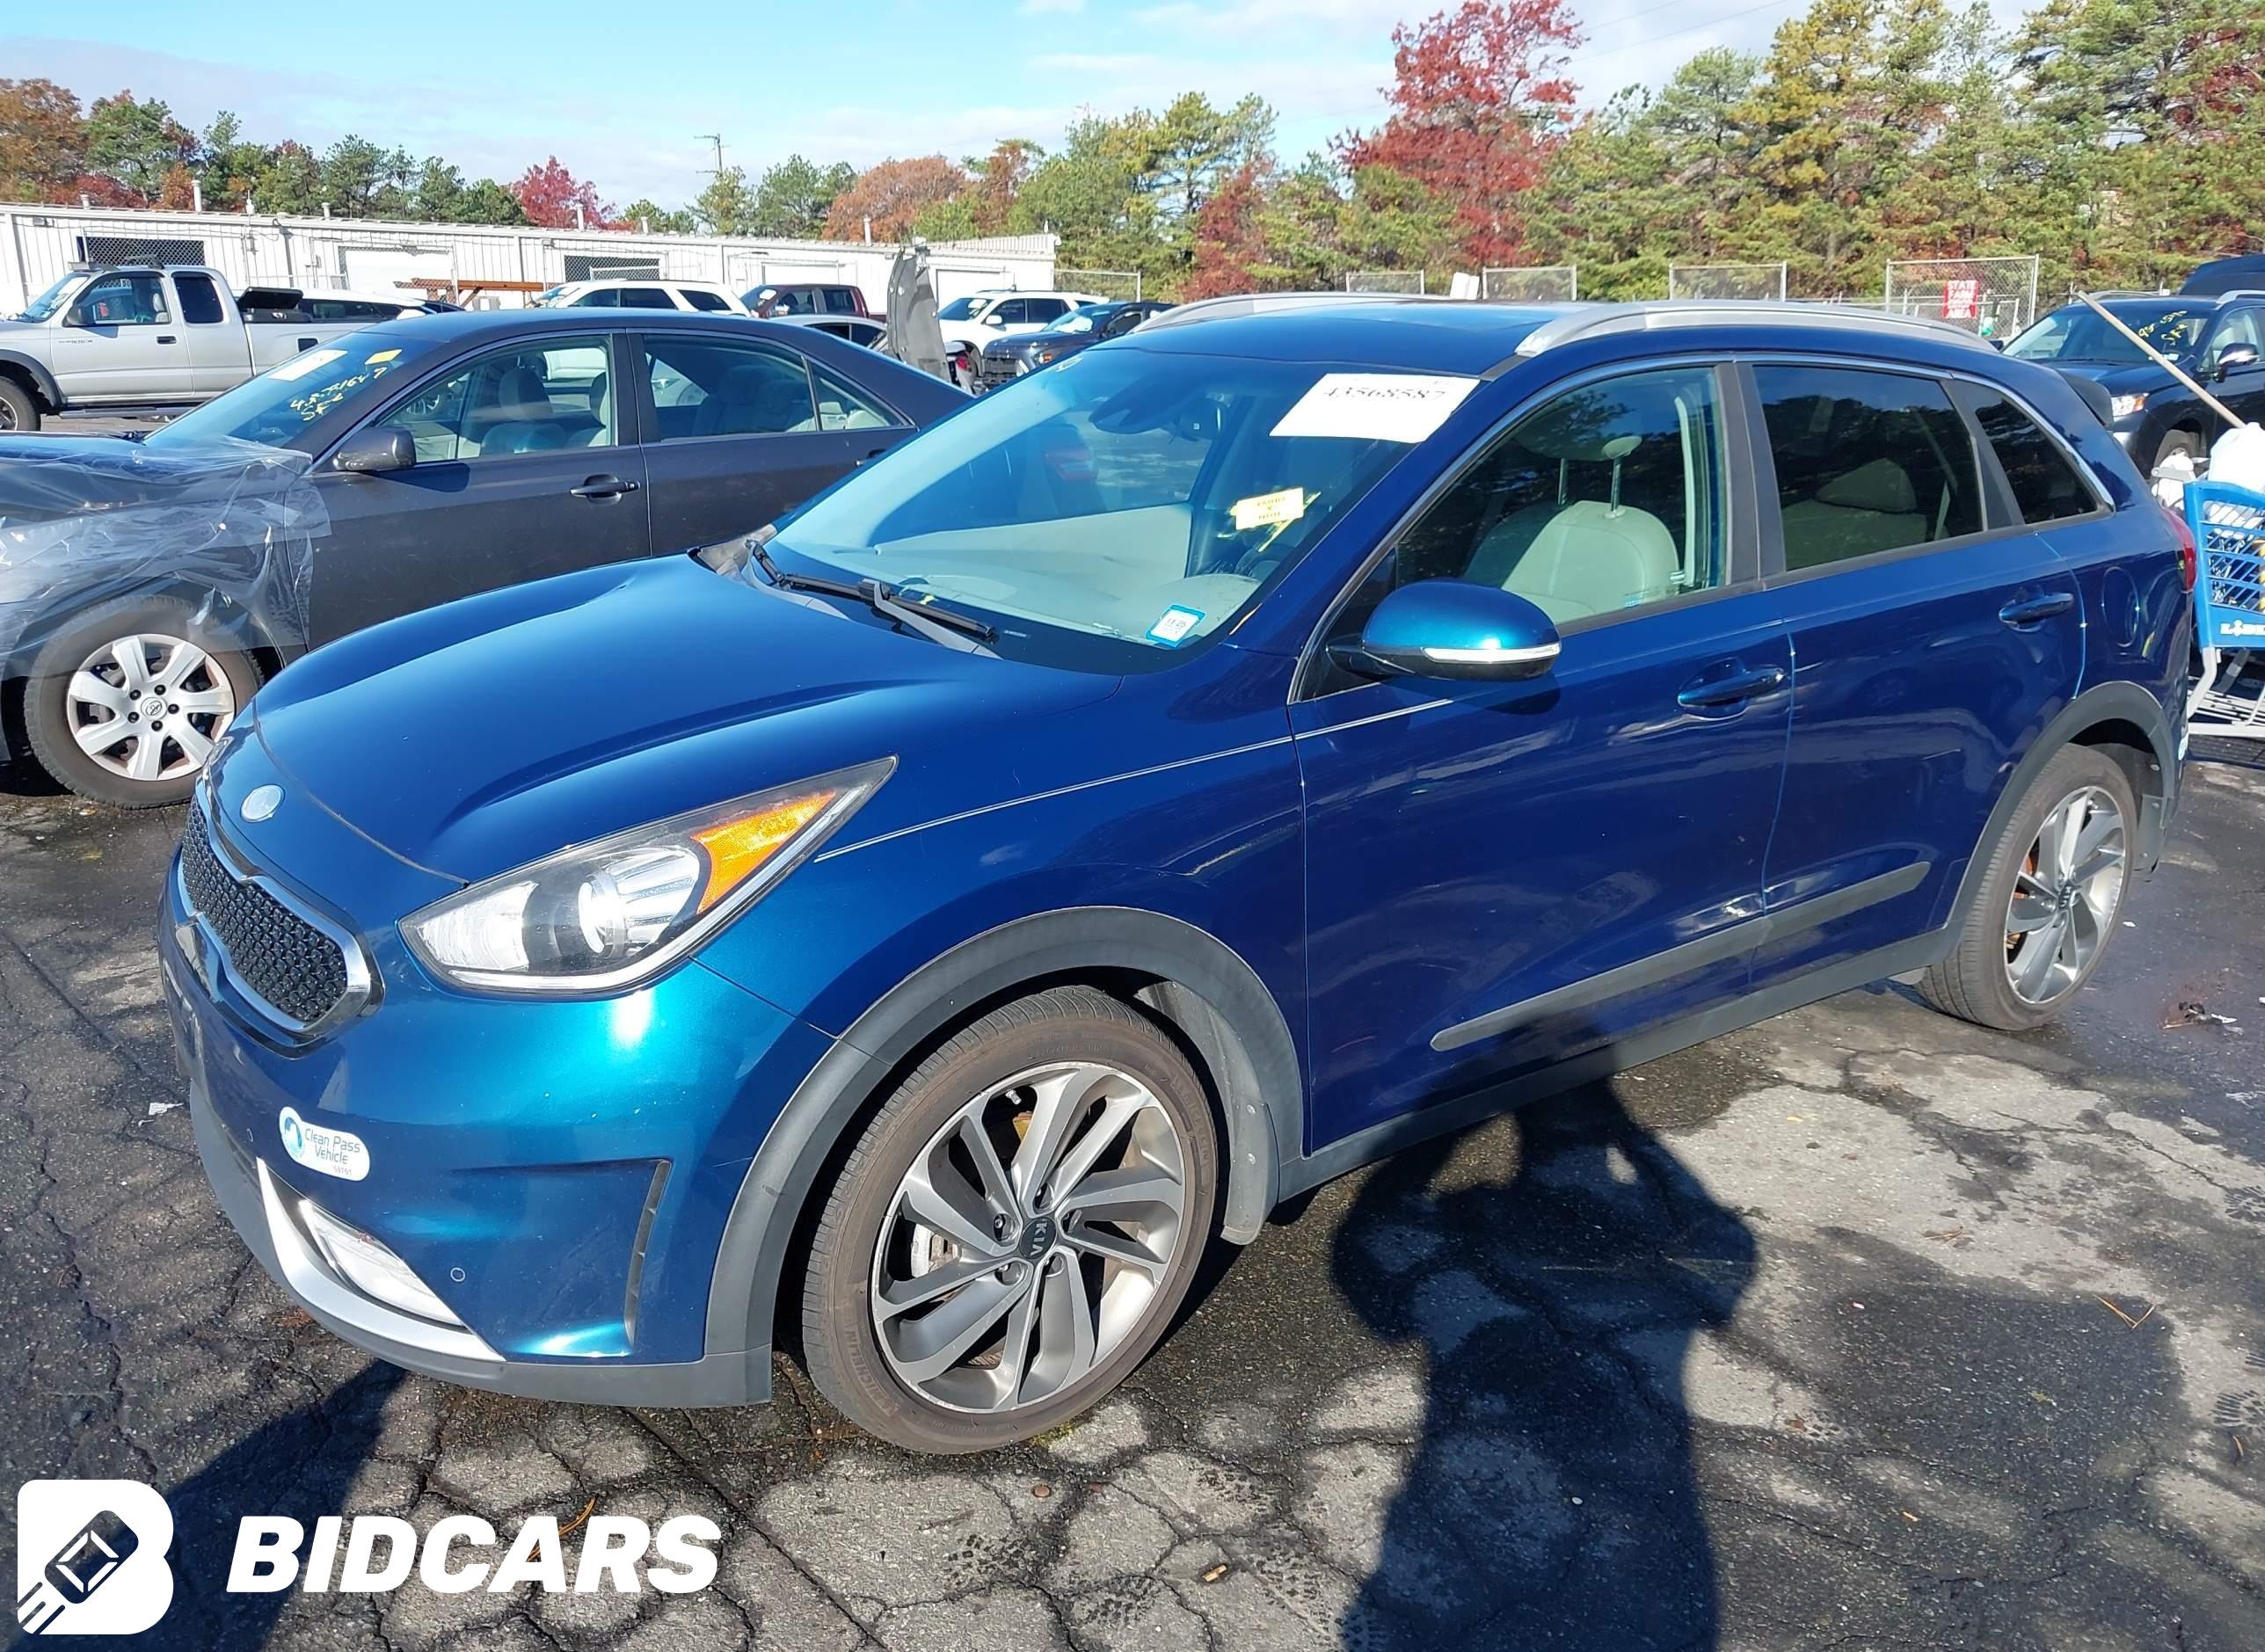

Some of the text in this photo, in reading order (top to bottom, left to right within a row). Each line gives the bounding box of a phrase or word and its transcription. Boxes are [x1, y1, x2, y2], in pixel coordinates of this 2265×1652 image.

[1948, 280, 1977, 290] STATE
[304, 1128, 361, 1153] Clean Pass
[314, 1145, 349, 1165] Vehicle
[1031, 1223, 1048, 1256] KIA
